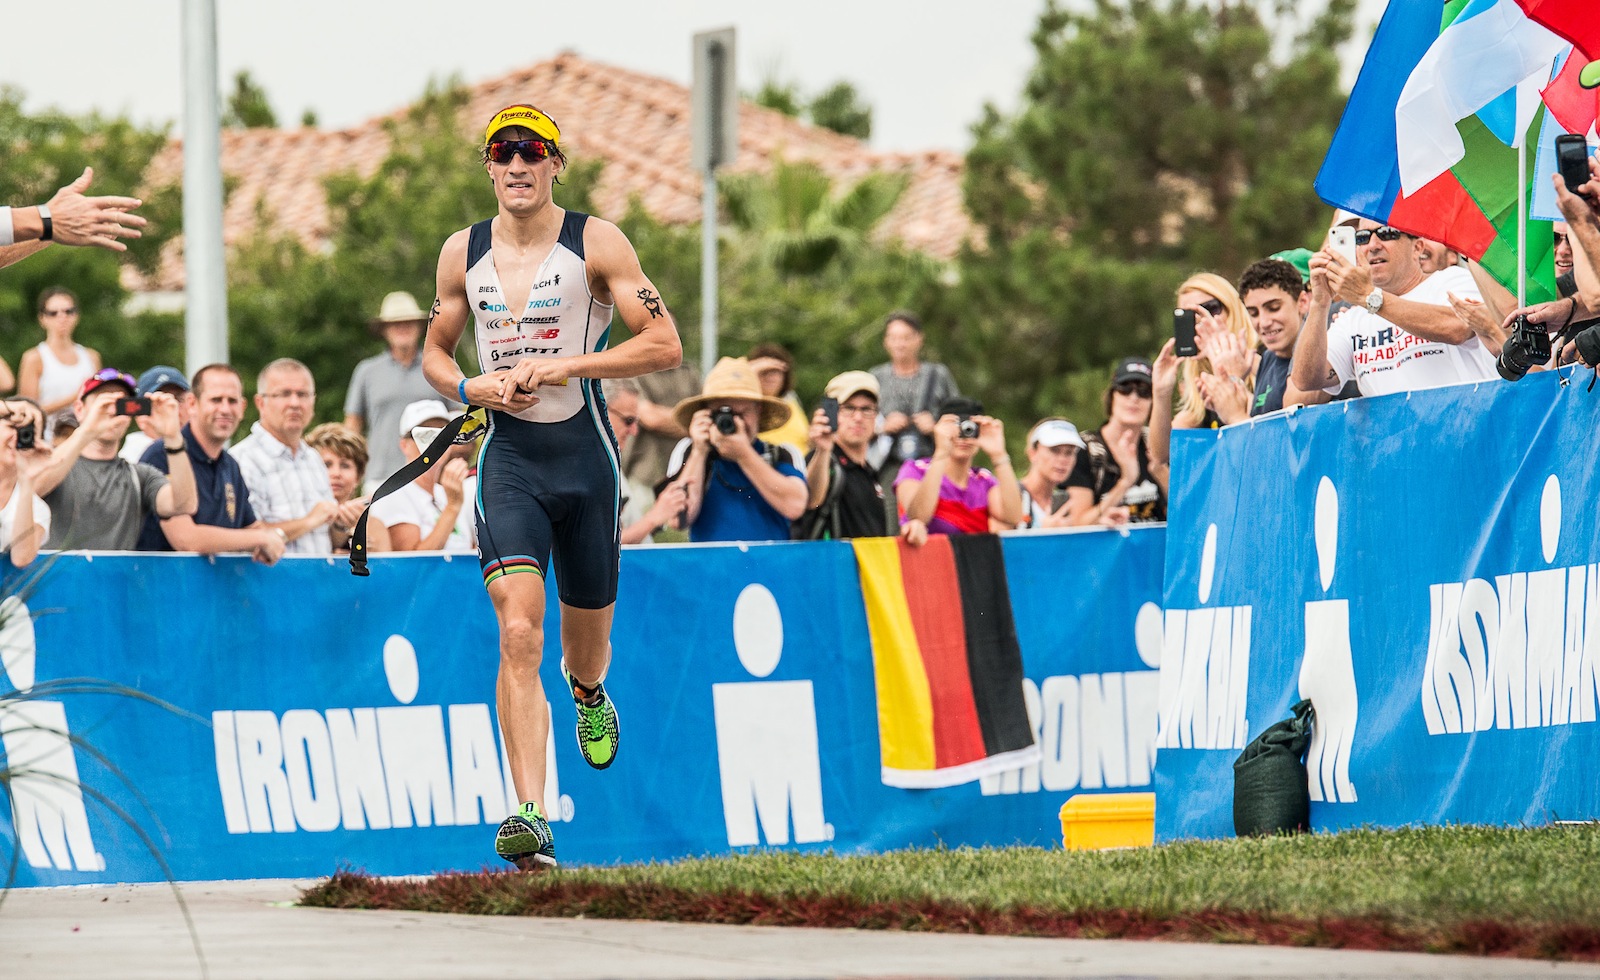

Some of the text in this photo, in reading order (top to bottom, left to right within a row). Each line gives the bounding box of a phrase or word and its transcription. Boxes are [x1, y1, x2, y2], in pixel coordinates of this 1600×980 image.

[500, 111, 540, 122] PowerBar
[500, 333, 526, 344] balane
[501, 347, 562, 357] SCOTT
